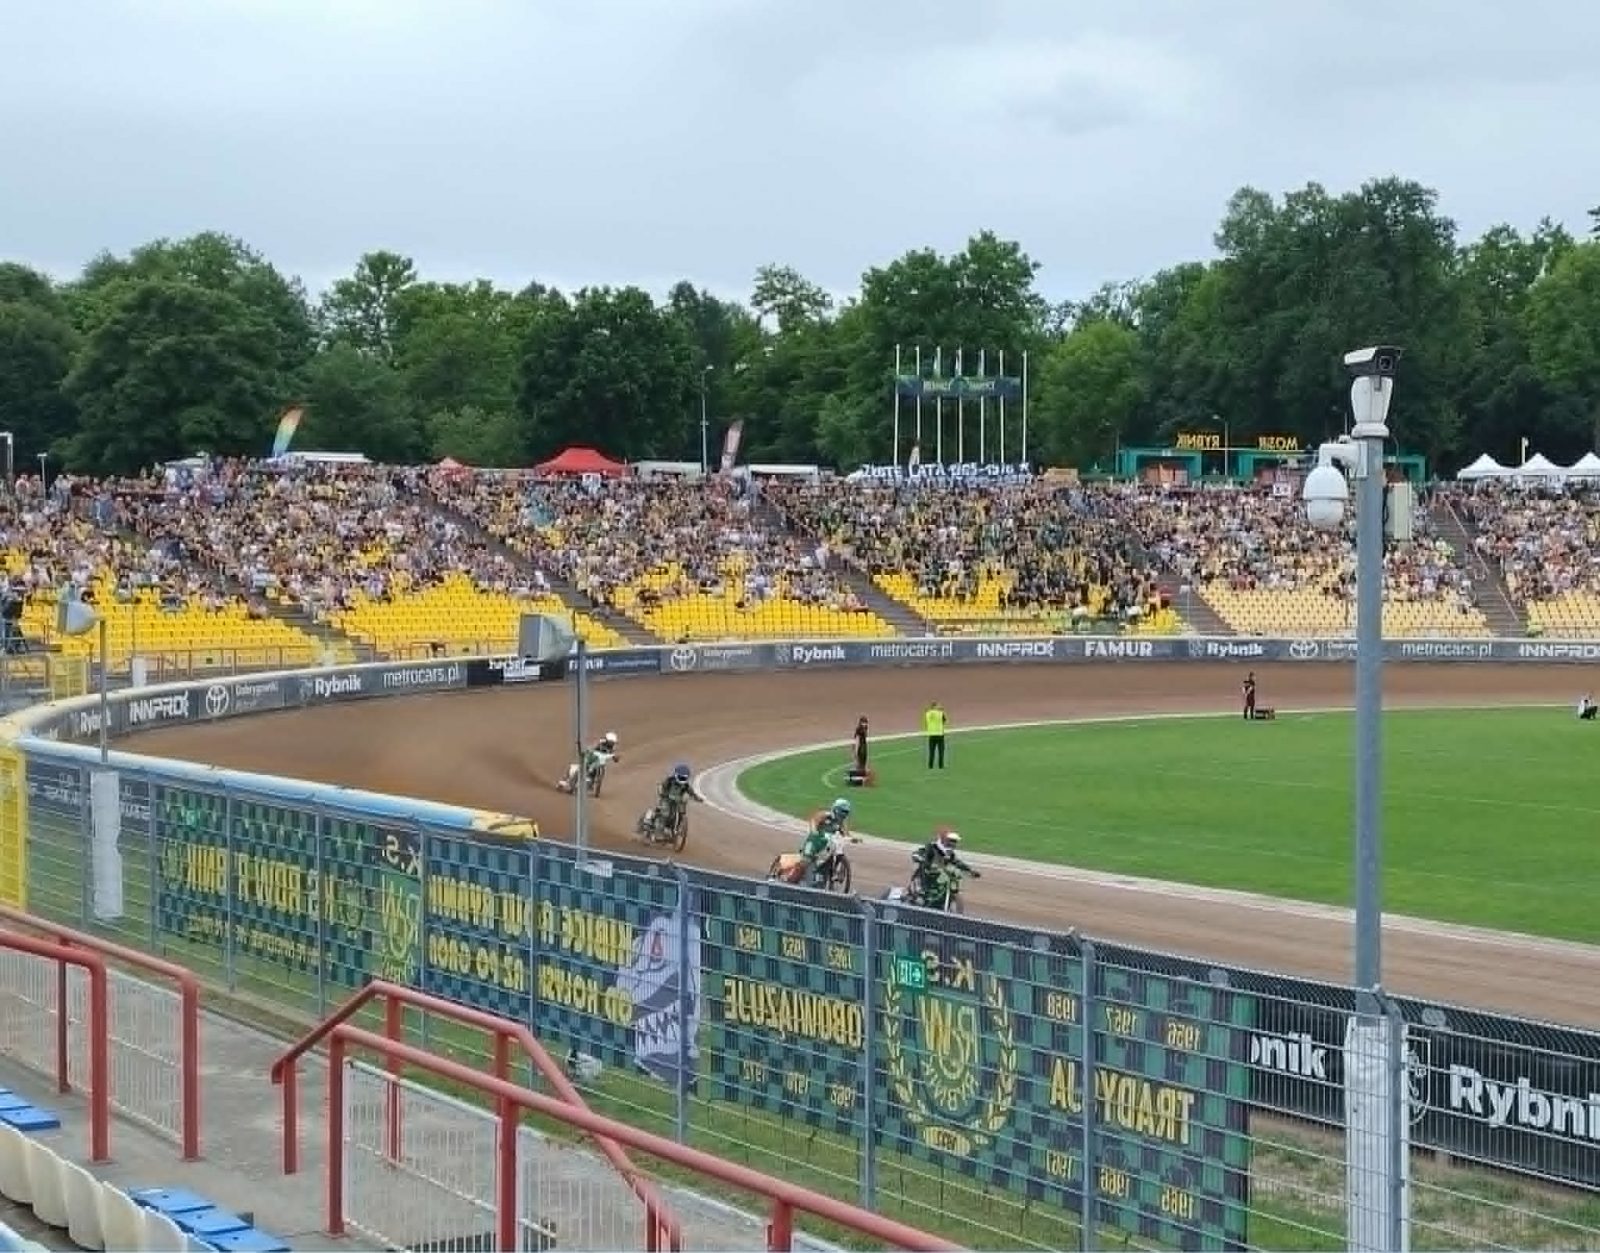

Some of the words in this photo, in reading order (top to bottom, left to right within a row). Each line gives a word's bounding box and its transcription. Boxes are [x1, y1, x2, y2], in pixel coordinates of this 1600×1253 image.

[793, 645, 845, 663] Rybnik
[871, 642, 952, 658] metrocars.pl
[1084, 641, 1153, 657] FAMUR
[1207, 642, 1263, 657] Rybnik
[1402, 642, 1492, 658] metrocars.pl
[383, 662, 458, 689] metrocars.pl
[315, 674, 361, 697] Rybnik
